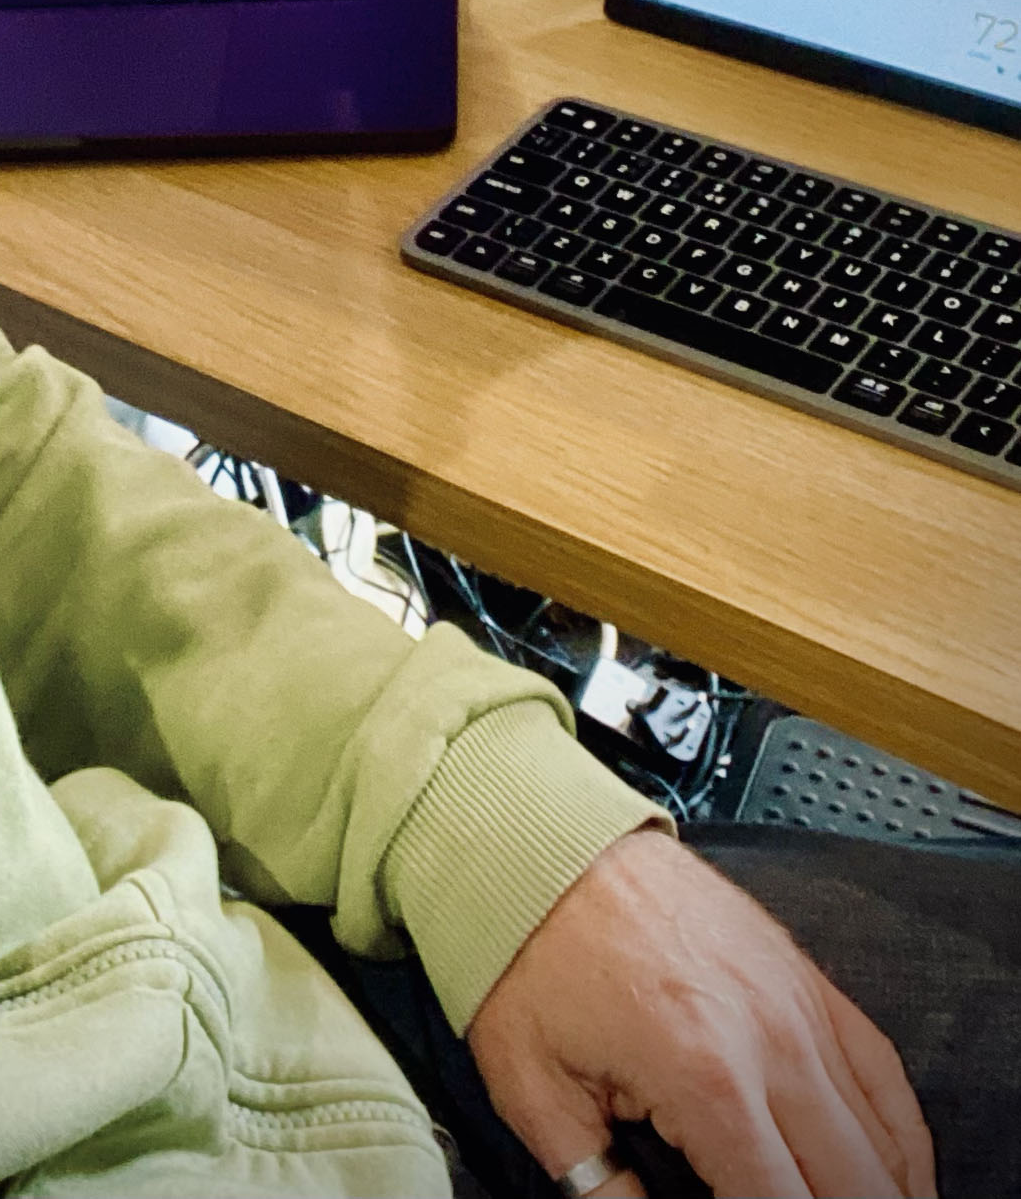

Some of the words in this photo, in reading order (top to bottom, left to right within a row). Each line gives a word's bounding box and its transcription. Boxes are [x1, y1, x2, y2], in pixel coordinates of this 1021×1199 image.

[974, 11, 1019, 53] 72
[616, 188, 635, 201] W
[559, 204, 572, 215] A
[660, 203, 676, 216] E
[602, 218, 617, 230] S
[704, 218, 720, 230] R
[553, 237, 570, 249] Z
[645, 233, 662, 245] D
[753, 232, 767, 244] T
[597, 251, 614, 264] X
[691, 248, 707, 258] F
[800, 248, 814, 260] Y
[642, 268, 659, 279] C
[736, 264, 753, 276] G
[845, 263, 862, 277] U
[689, 283, 706, 295] V
[783, 280, 802, 293] H
[734, 299, 750, 312] B
[833, 297, 848, 308] J
[943, 297, 961, 310] O
[782, 315, 800, 329] N
[881, 313, 899, 327] K
[995, 314, 1014, 325] P
[829, 332, 850, 347] M
[933, 330, 944, 343] L
